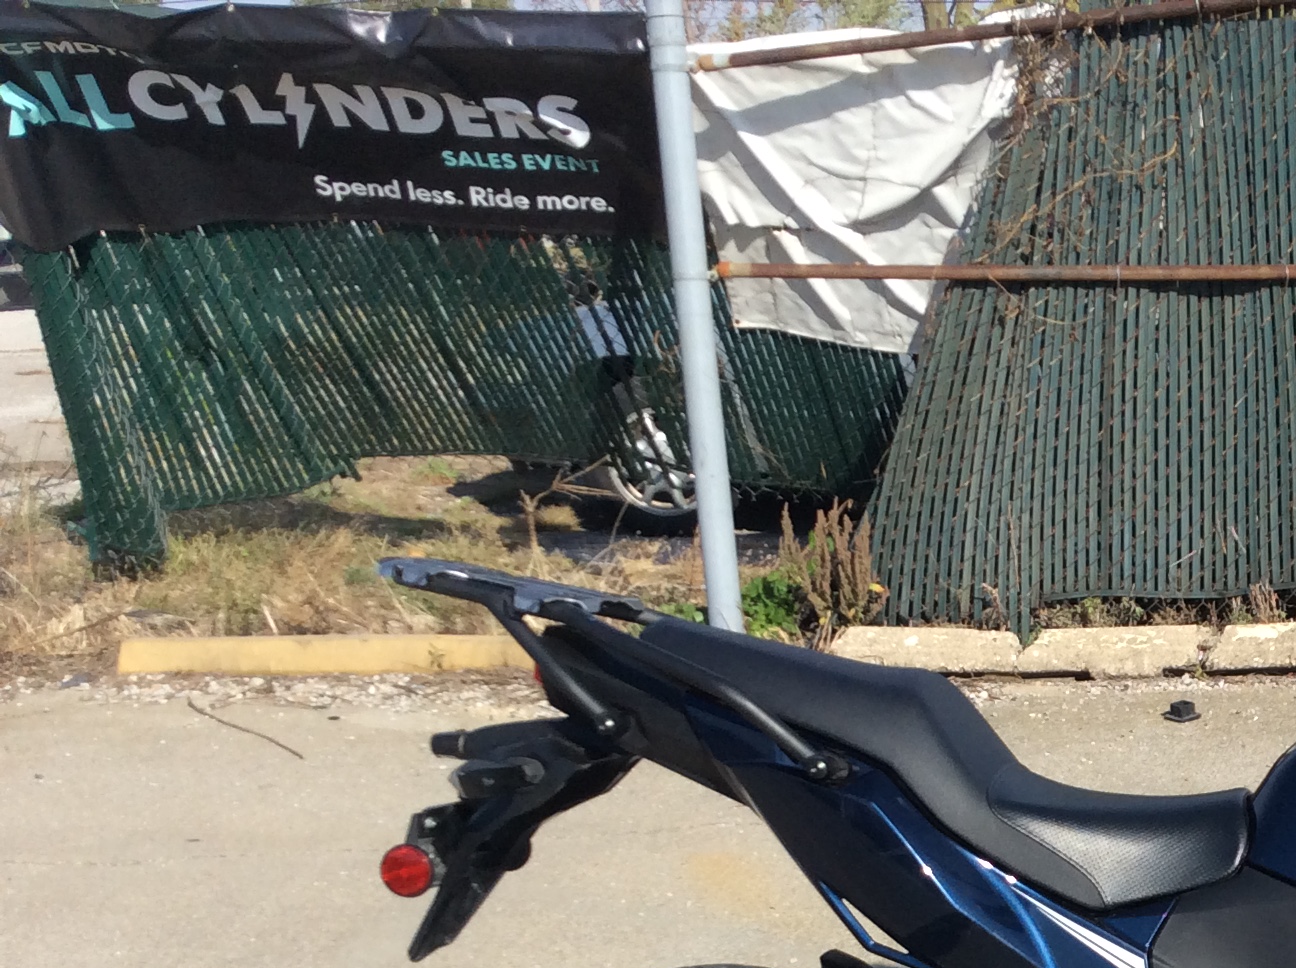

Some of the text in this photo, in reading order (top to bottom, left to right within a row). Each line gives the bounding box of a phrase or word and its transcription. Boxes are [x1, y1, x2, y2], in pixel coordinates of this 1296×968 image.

[441, 150, 600, 173] SALES EVENT
[313, 174, 616, 213] Spend less. Ride more.
